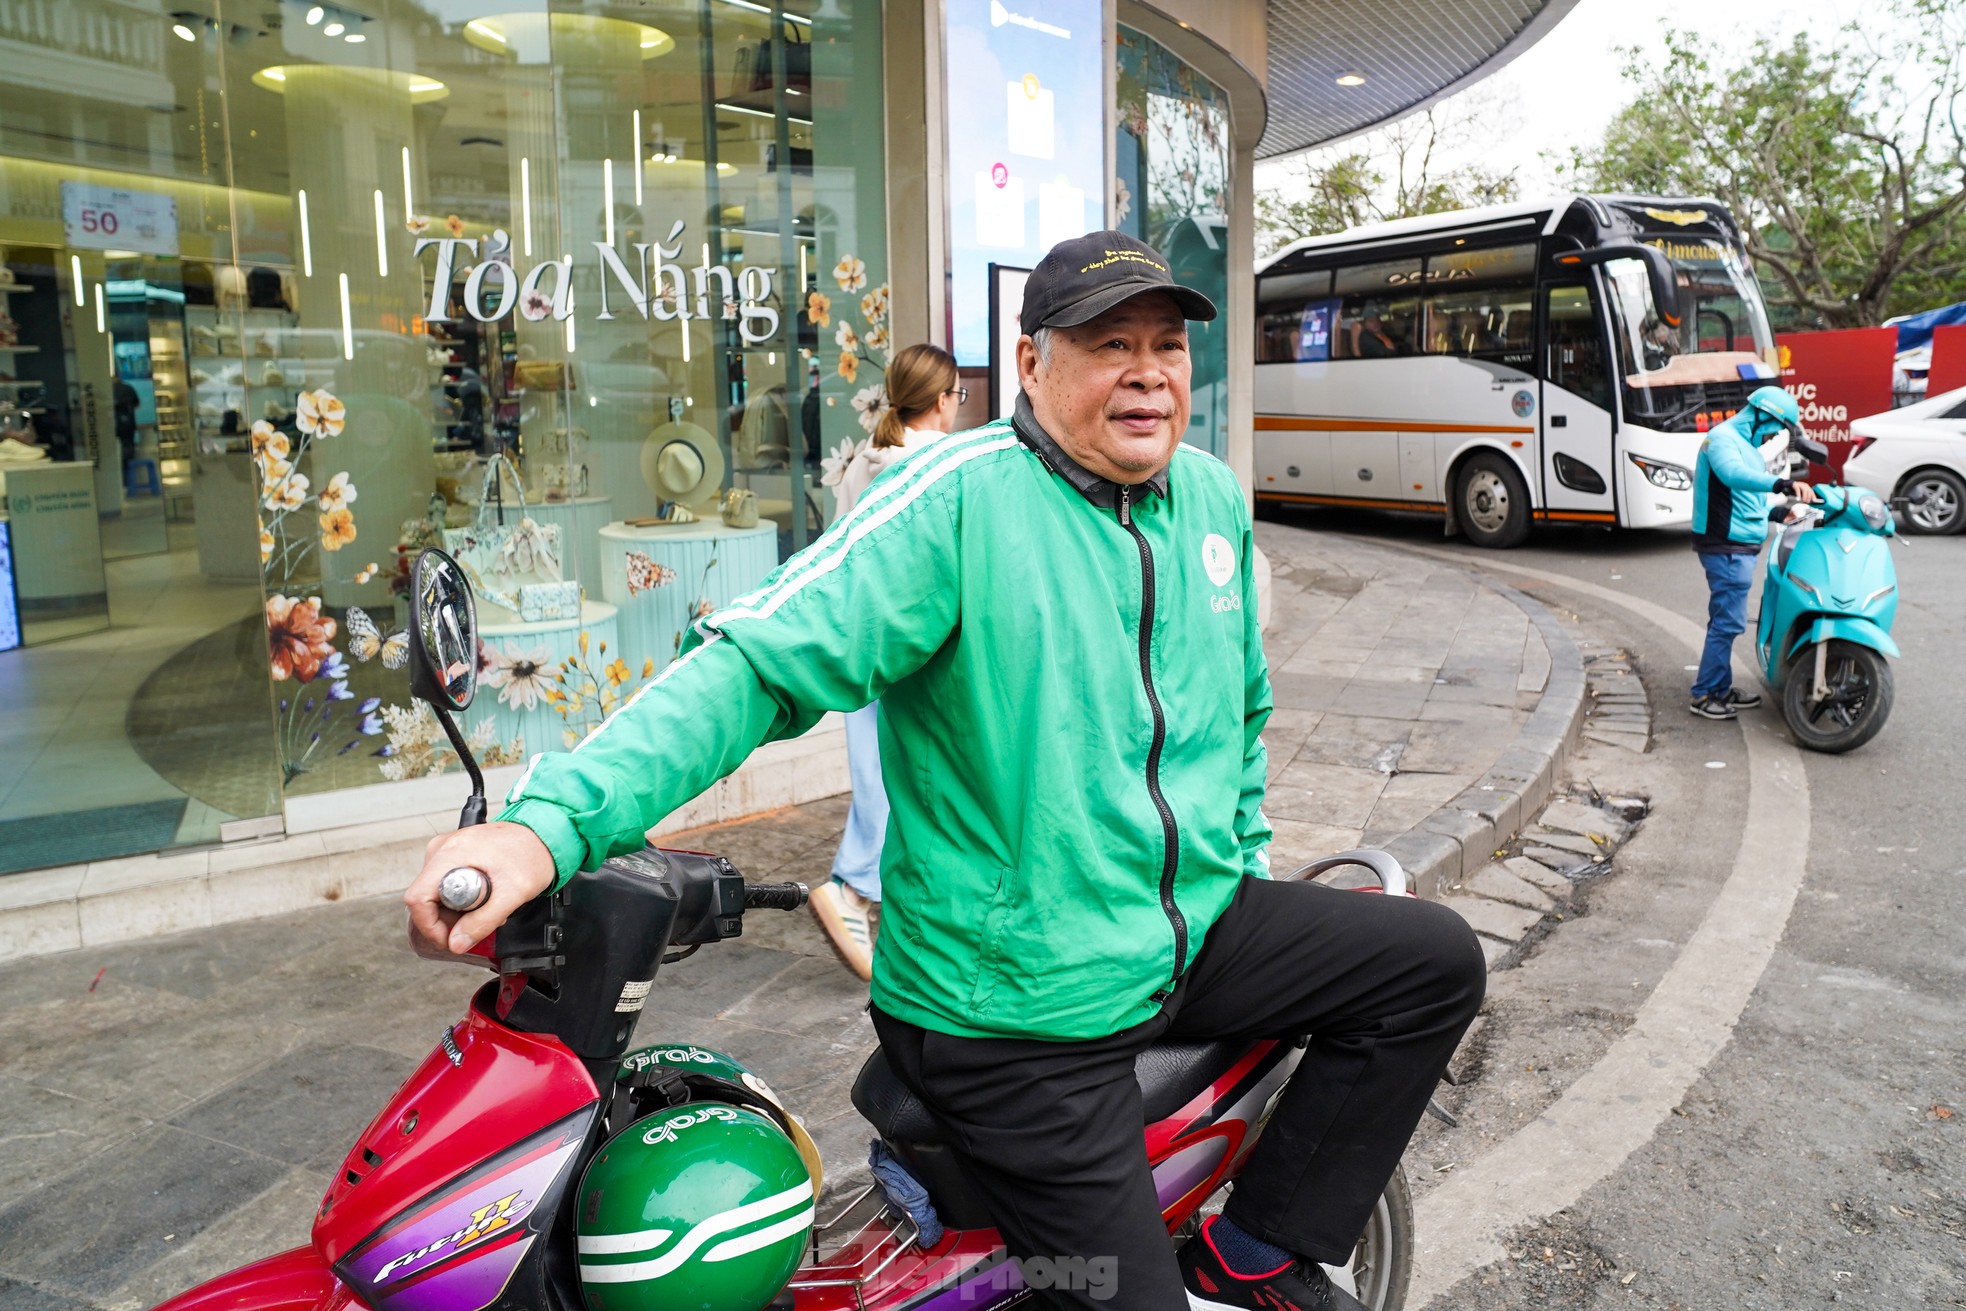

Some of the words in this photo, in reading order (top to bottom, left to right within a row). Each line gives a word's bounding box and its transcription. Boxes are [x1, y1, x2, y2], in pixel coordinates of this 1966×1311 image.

[82, 210, 118, 236] 50
[413, 229, 577, 322] Tỏa
[592, 219, 781, 342] Nắng
[1210, 589, 1240, 613] Grab
[622, 1047, 714, 1070] Grab
[642, 1107, 738, 1145] Grab
[372, 1200, 533, 1284] Future
